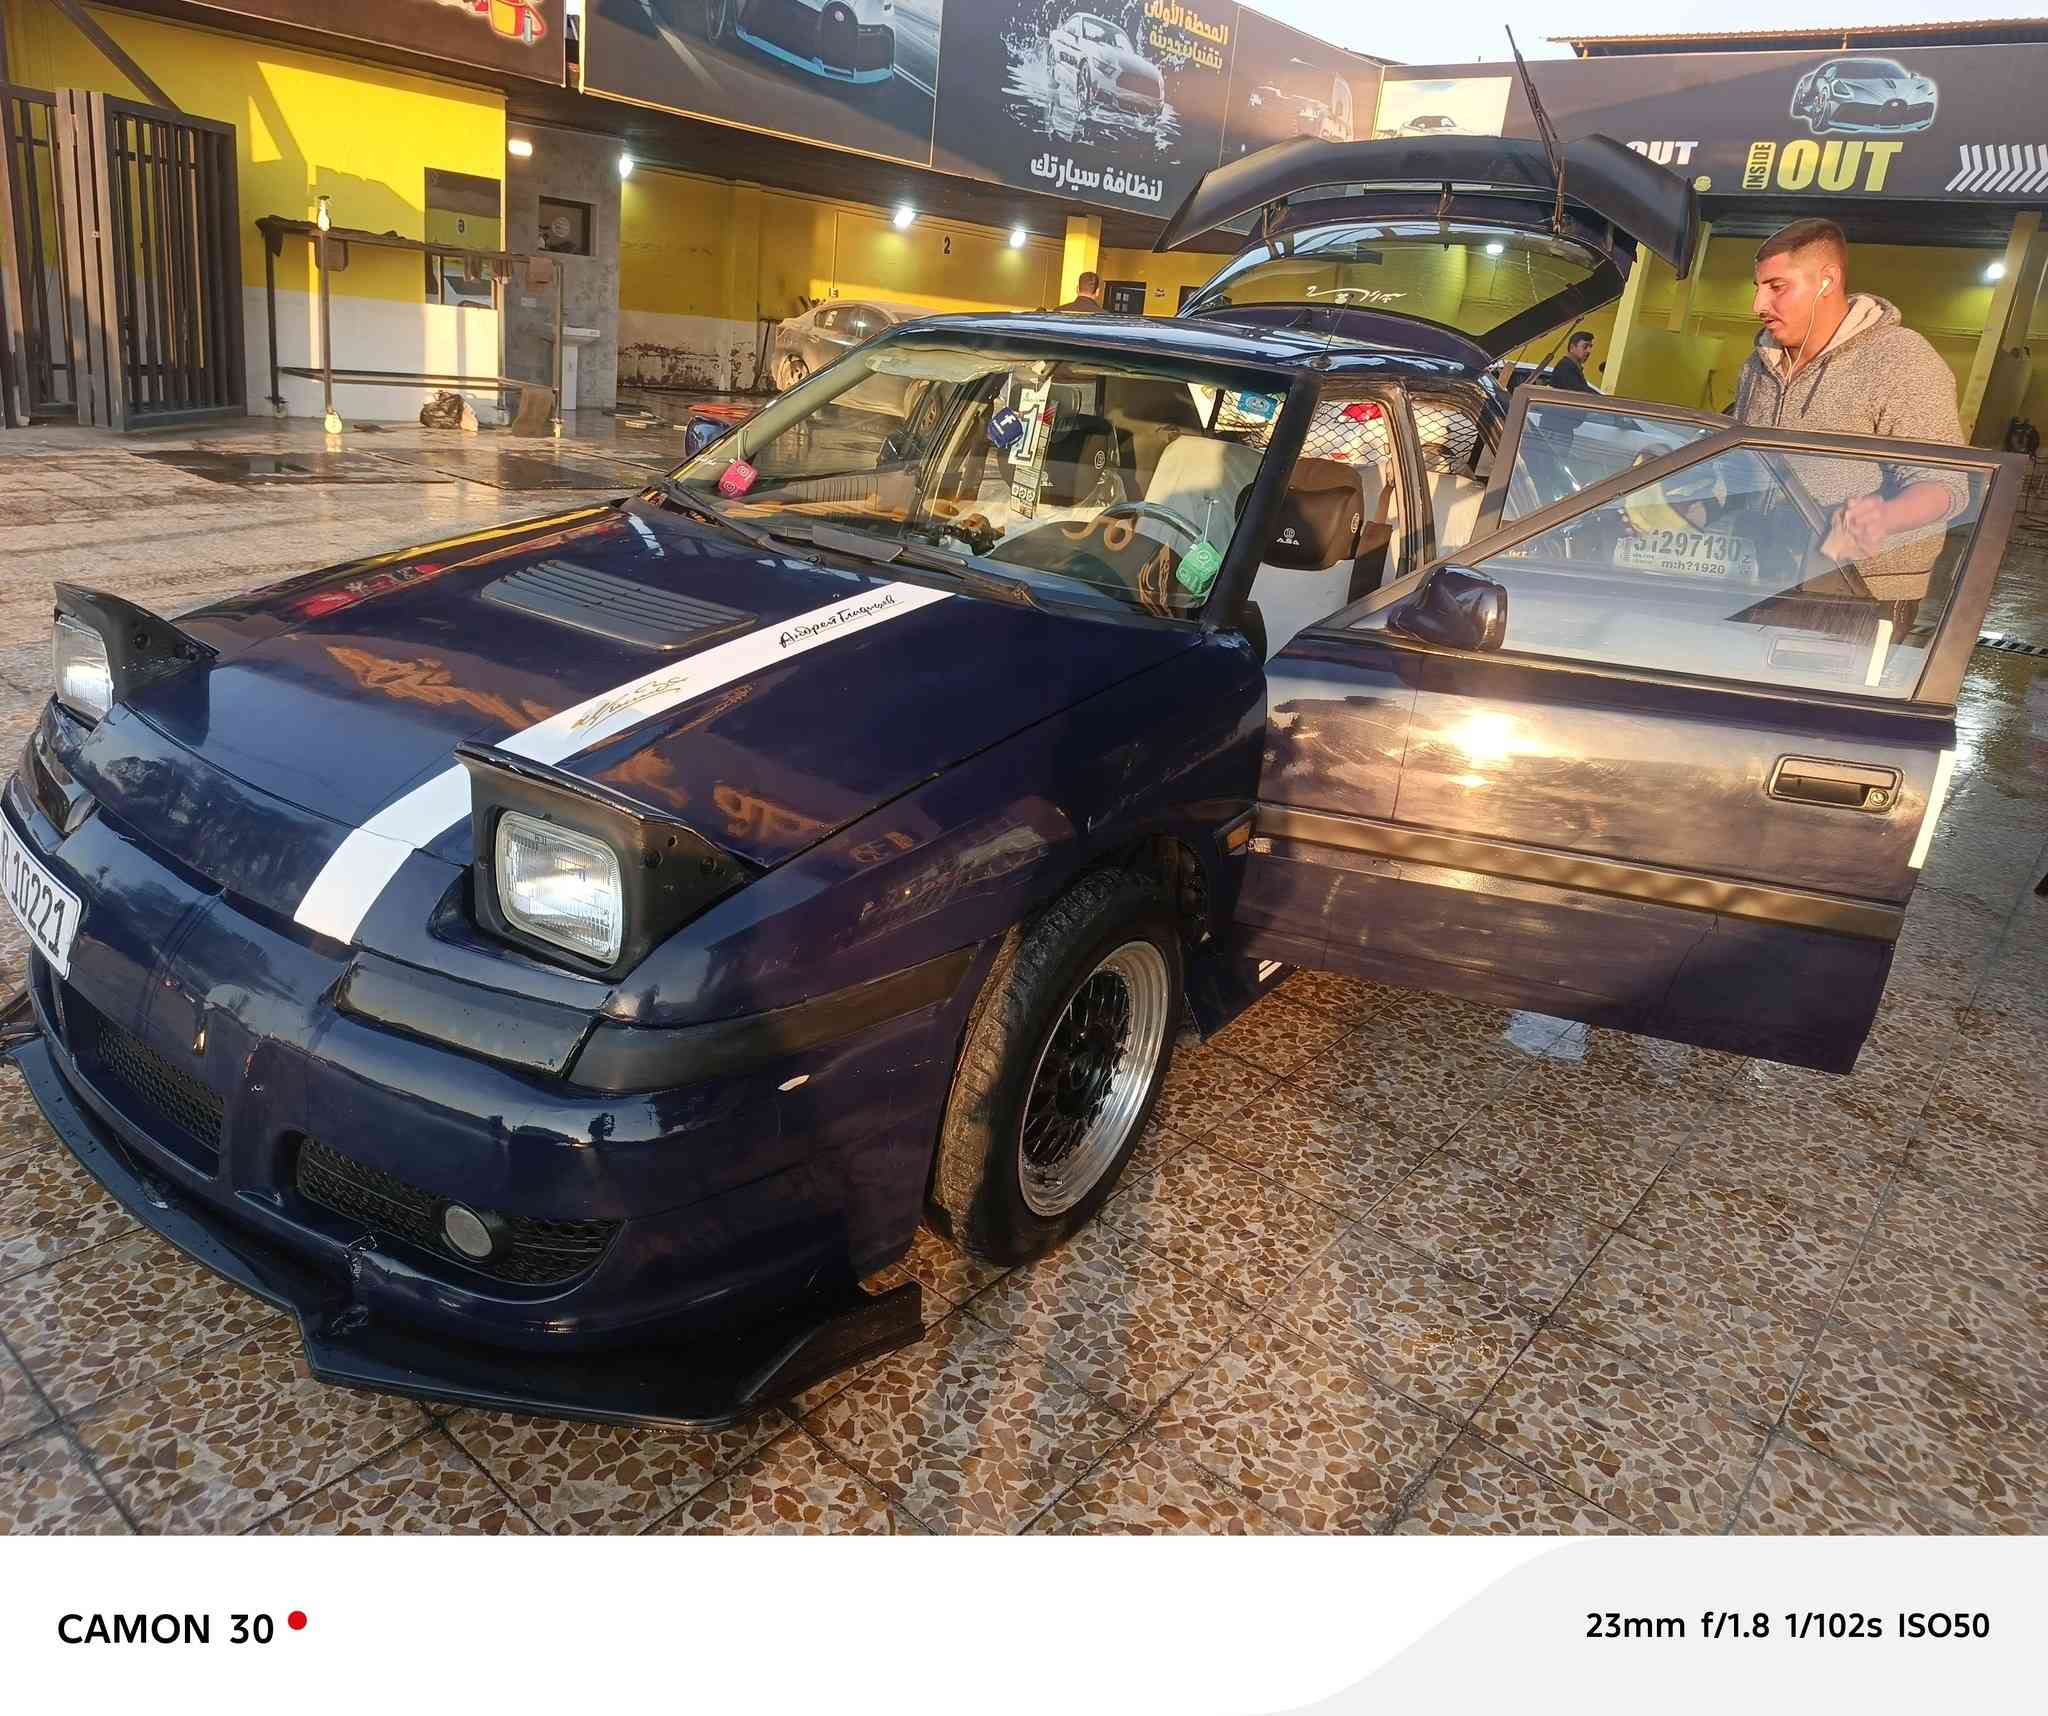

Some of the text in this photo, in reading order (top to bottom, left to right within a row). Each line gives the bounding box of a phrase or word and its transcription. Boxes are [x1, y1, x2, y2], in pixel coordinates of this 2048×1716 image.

[1184, 9, 1229, 46] المحطة
[1031, 153, 1163, 202] لنظافة سيارتك
[1745, 143, 1772, 188] INSIDE
[1777, 139, 1904, 191] OUT
[943, 235, 951, 255] 2
[11, 850, 66, 958] 10221
